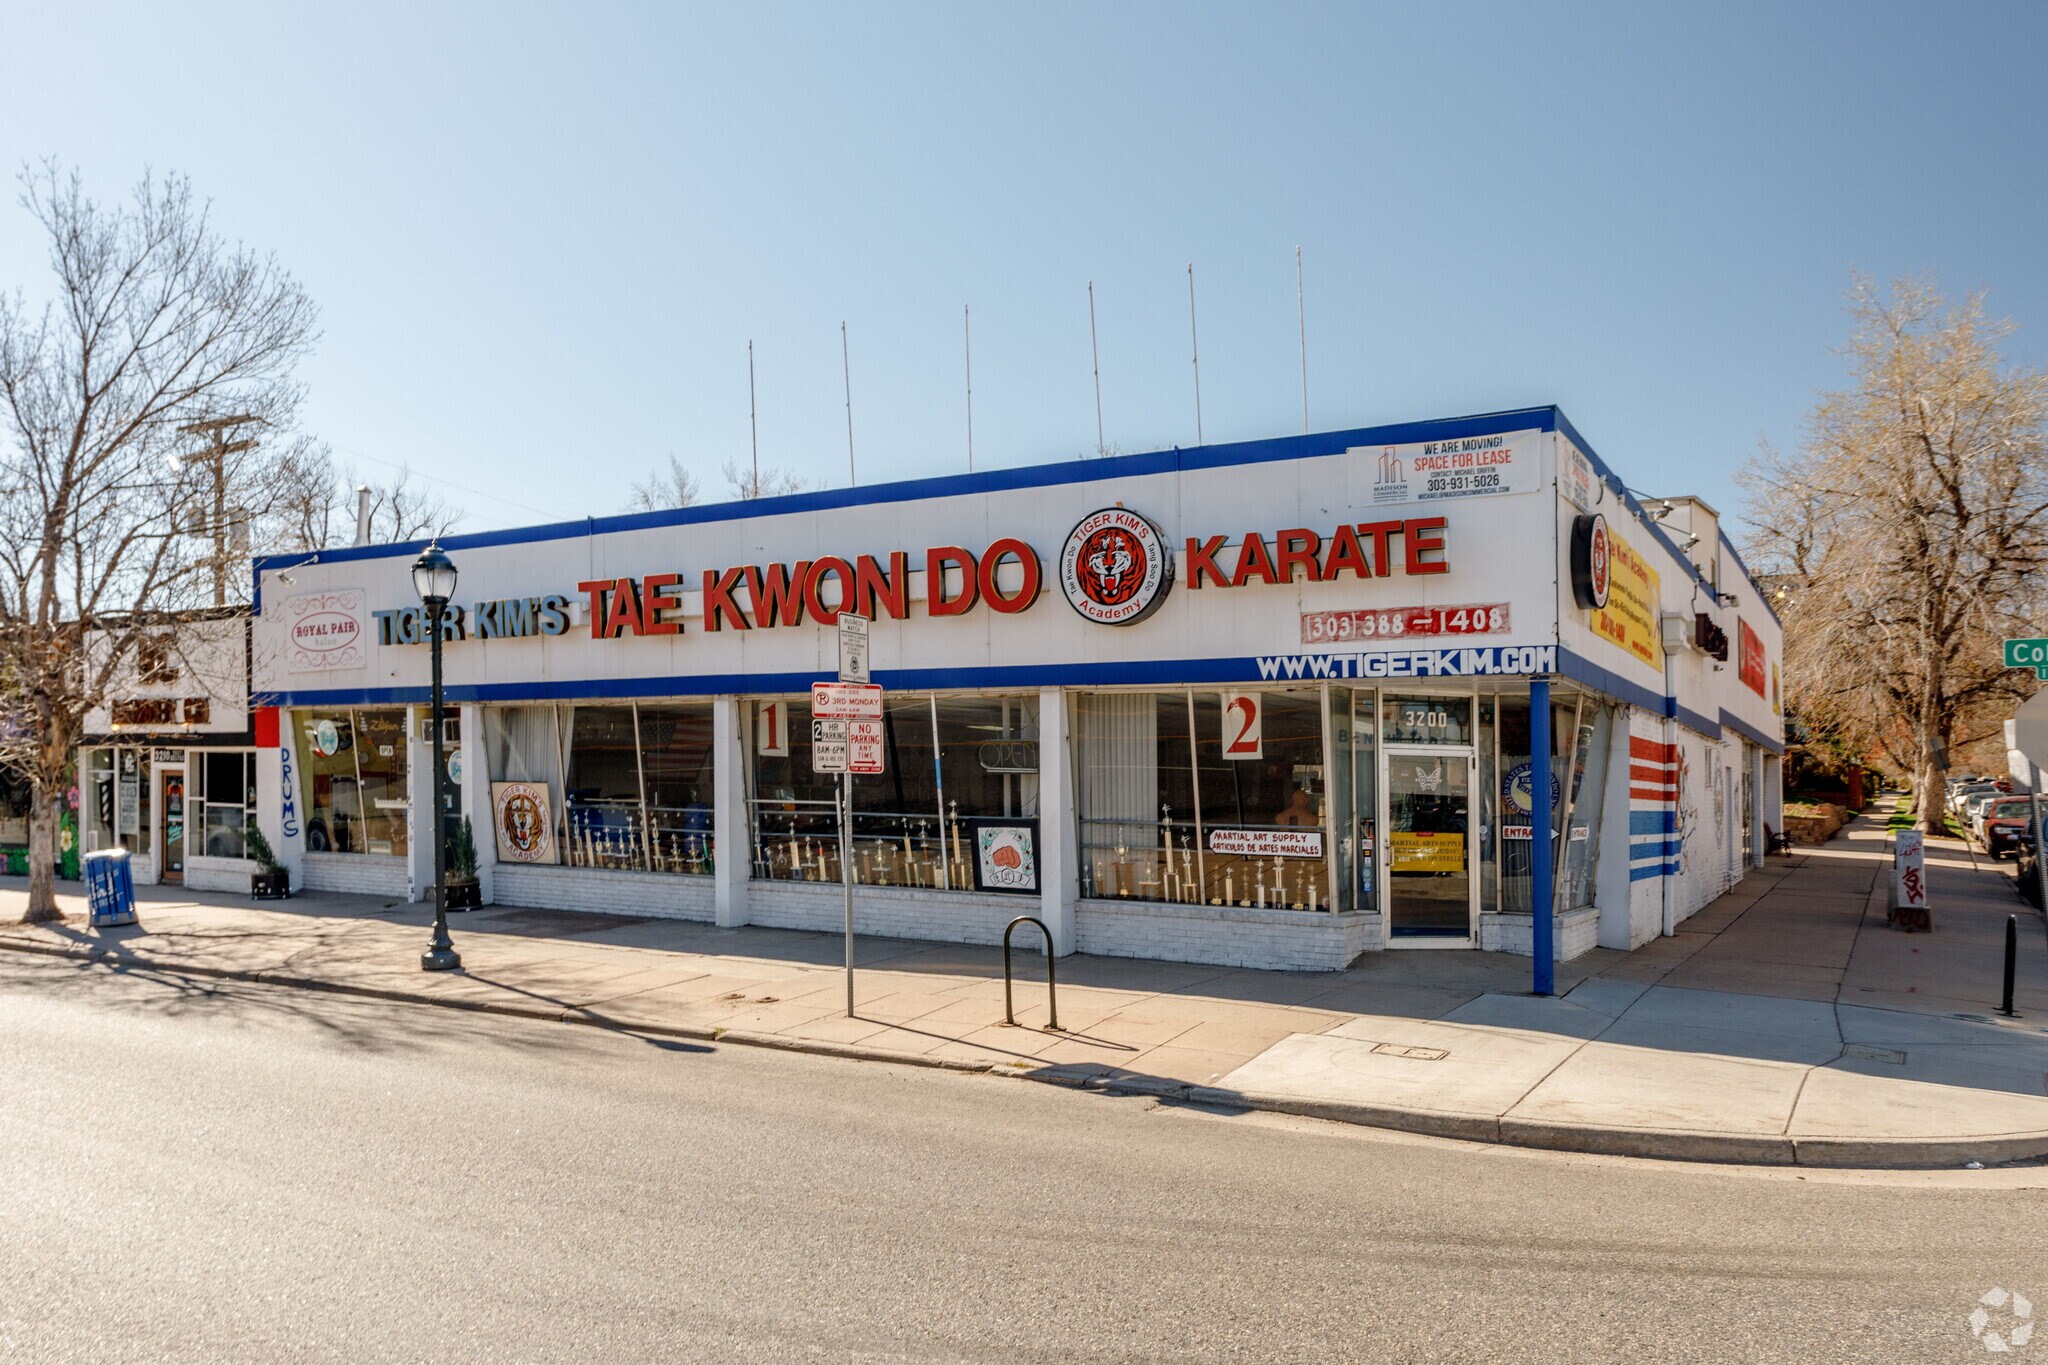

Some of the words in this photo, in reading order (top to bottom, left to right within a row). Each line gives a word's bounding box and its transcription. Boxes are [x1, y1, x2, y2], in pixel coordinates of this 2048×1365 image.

[1424, 443, 1438, 455] WE
[1441, 441, 1459, 453] ARE
[1462, 436, 1503, 452] MOVING!
[1414, 455, 1449, 471] SPACE
[1452, 453, 1473, 468] FOR
[1476, 449, 1512, 466] LEASE
[1454, 468, 1476, 476] MICHAEL
[1427, 474, 1500, 491] 303-931-5026
[1073, 514, 1112, 542] TIGER
[1115, 514, 1149, 539] KIM'S
[1068, 546, 1076, 557] Do
[1148, 542, 1157, 562] Tang
[1185, 516, 1450, 590] KARATE
[926, 537, 1043, 617] DO
[1150, 563, 1158, 579] Soo
[702, 550, 909, 632] KWON
[1145, 581, 1154, 592] Do
[577, 573, 684, 639] TAE
[1079, 599, 1141, 619] Academy
[297, 624, 328, 637] ROYAL
[331, 621, 355, 634] PAIR
[372, 604, 466, 646] TIGER
[474, 595, 571, 639] KIM'S
[1256, 645, 1558, 681] WWW.TIGERKIM.COM
[849, 698, 879, 706] MONDAY
[762, 704, 780, 750] 1
[829, 723, 838, 731] HR
[1226, 696, 1260, 753] 2
[1406, 711, 1447, 728] 3200
[814, 724, 821, 739] 2
[822, 732, 846, 740] PARKING
[859, 724, 871, 734] NO
[851, 735, 879, 744] PARKING
[979, 742, 1036, 768] OPEN
[281, 748, 299, 838] DRUMS
[1214, 832, 1250, 841] MARTIAL
[1253, 833, 1267, 841] ART
[1272, 834, 1307, 843] SUPPLY
[1504, 828, 1533, 838] ENTRA
[508, 844, 543, 860] ACADEMY
[1212, 843, 1245, 851] ARTICULOS
[1247, 844, 1256, 852] DE
[1258, 844, 1278, 853] ARTES
[1280, 845, 1319, 855] MARCIALES
